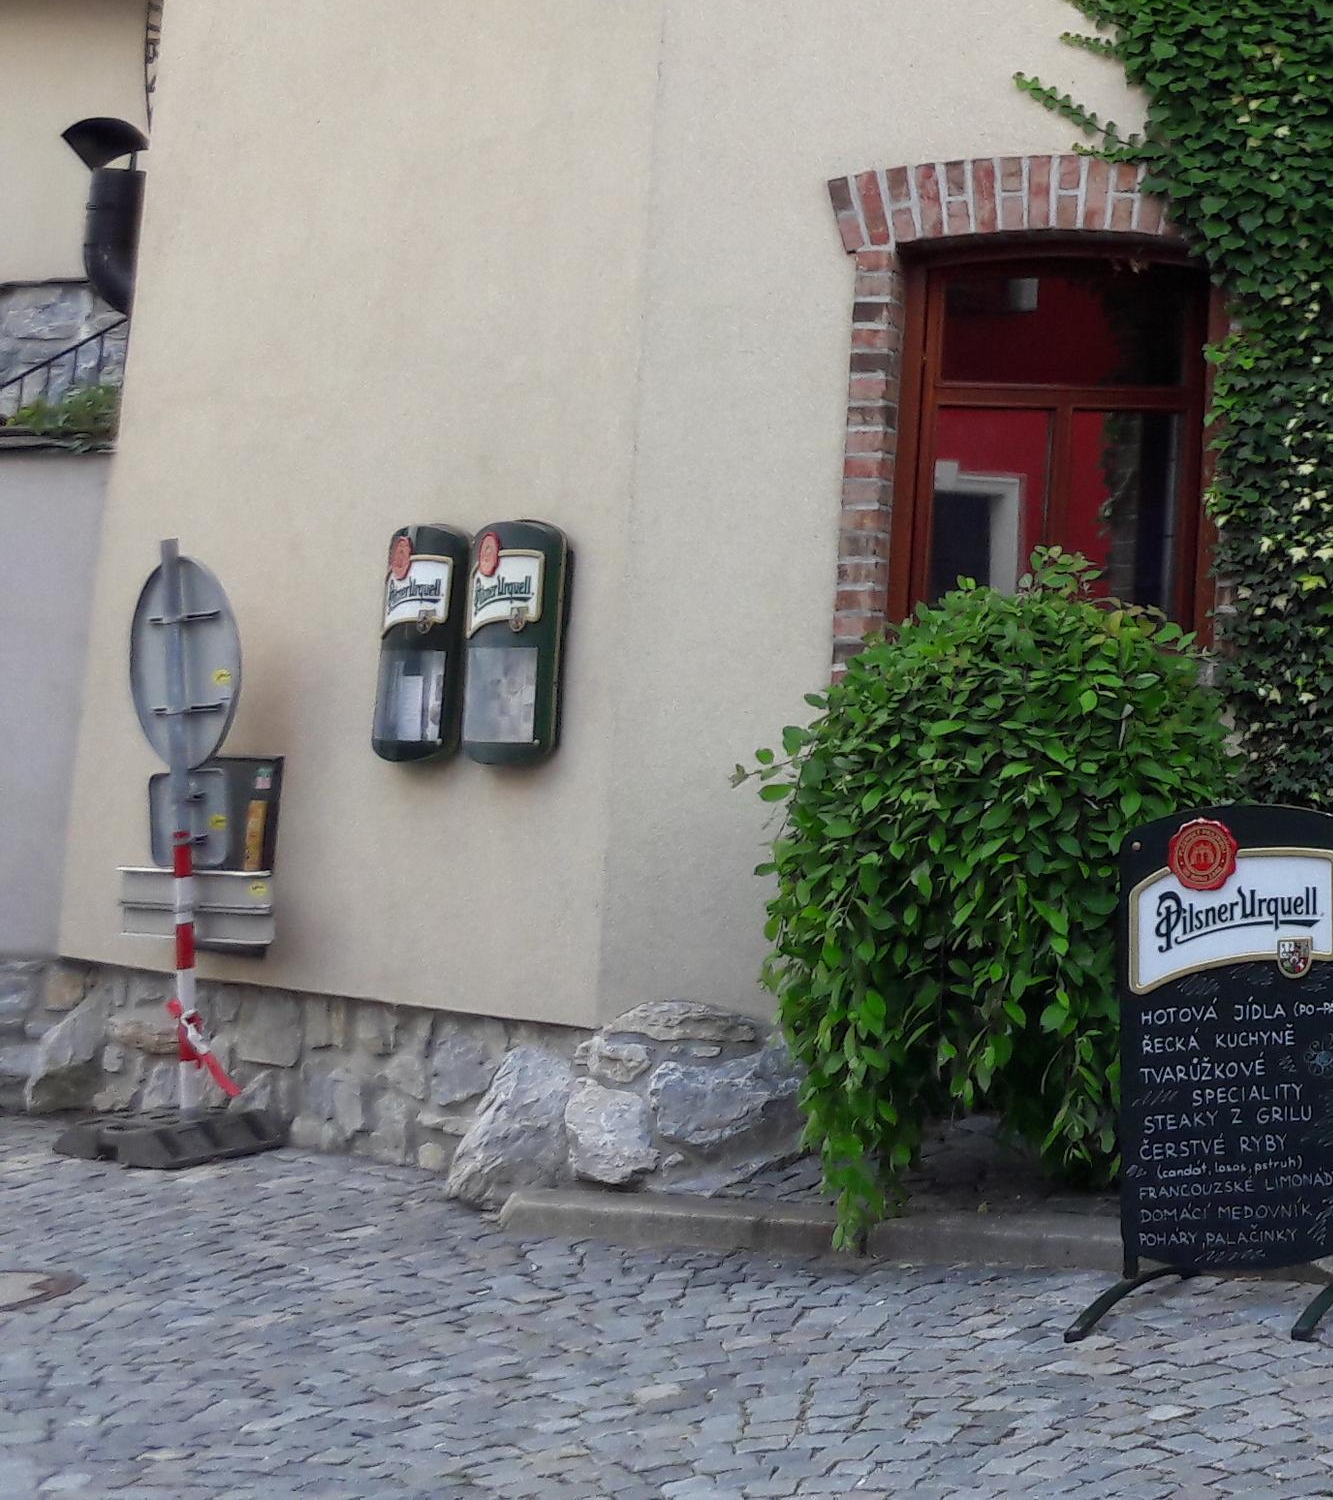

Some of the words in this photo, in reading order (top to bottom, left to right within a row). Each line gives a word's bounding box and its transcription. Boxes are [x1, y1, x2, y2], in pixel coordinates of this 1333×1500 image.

[1155, 890, 1239, 953] Pilsner
[1237, 885, 1318, 931] Urquell
[1140, 997, 1218, 1026] HOTOVÁ
[1233, 996, 1287, 1021] JÍDLA
[1142, 1027, 1200, 1055] ŘECKÁ
[1215, 1023, 1296, 1049] KUCHYNĚ
[1139, 1052, 1266, 1084] TVARŮŽKOVÉ
[1192, 1083, 1303, 1107] SPECIALITY
[1144, 1110, 1218, 1135] STEAKY
[1230, 1108, 1243, 1124] Z
[1256, 1105, 1312, 1125] GRILU
[1139, 1133, 1226, 1161] ČERSTVÉ
[1239, 1133, 1287, 1153] RYBY
[1139, 1176, 1255, 1201] FRANCOUZSKÉ
[1140, 1202, 1211, 1224] DOMÁCÍ
[1218, 1197, 1313, 1221] MEDOVNÍK
